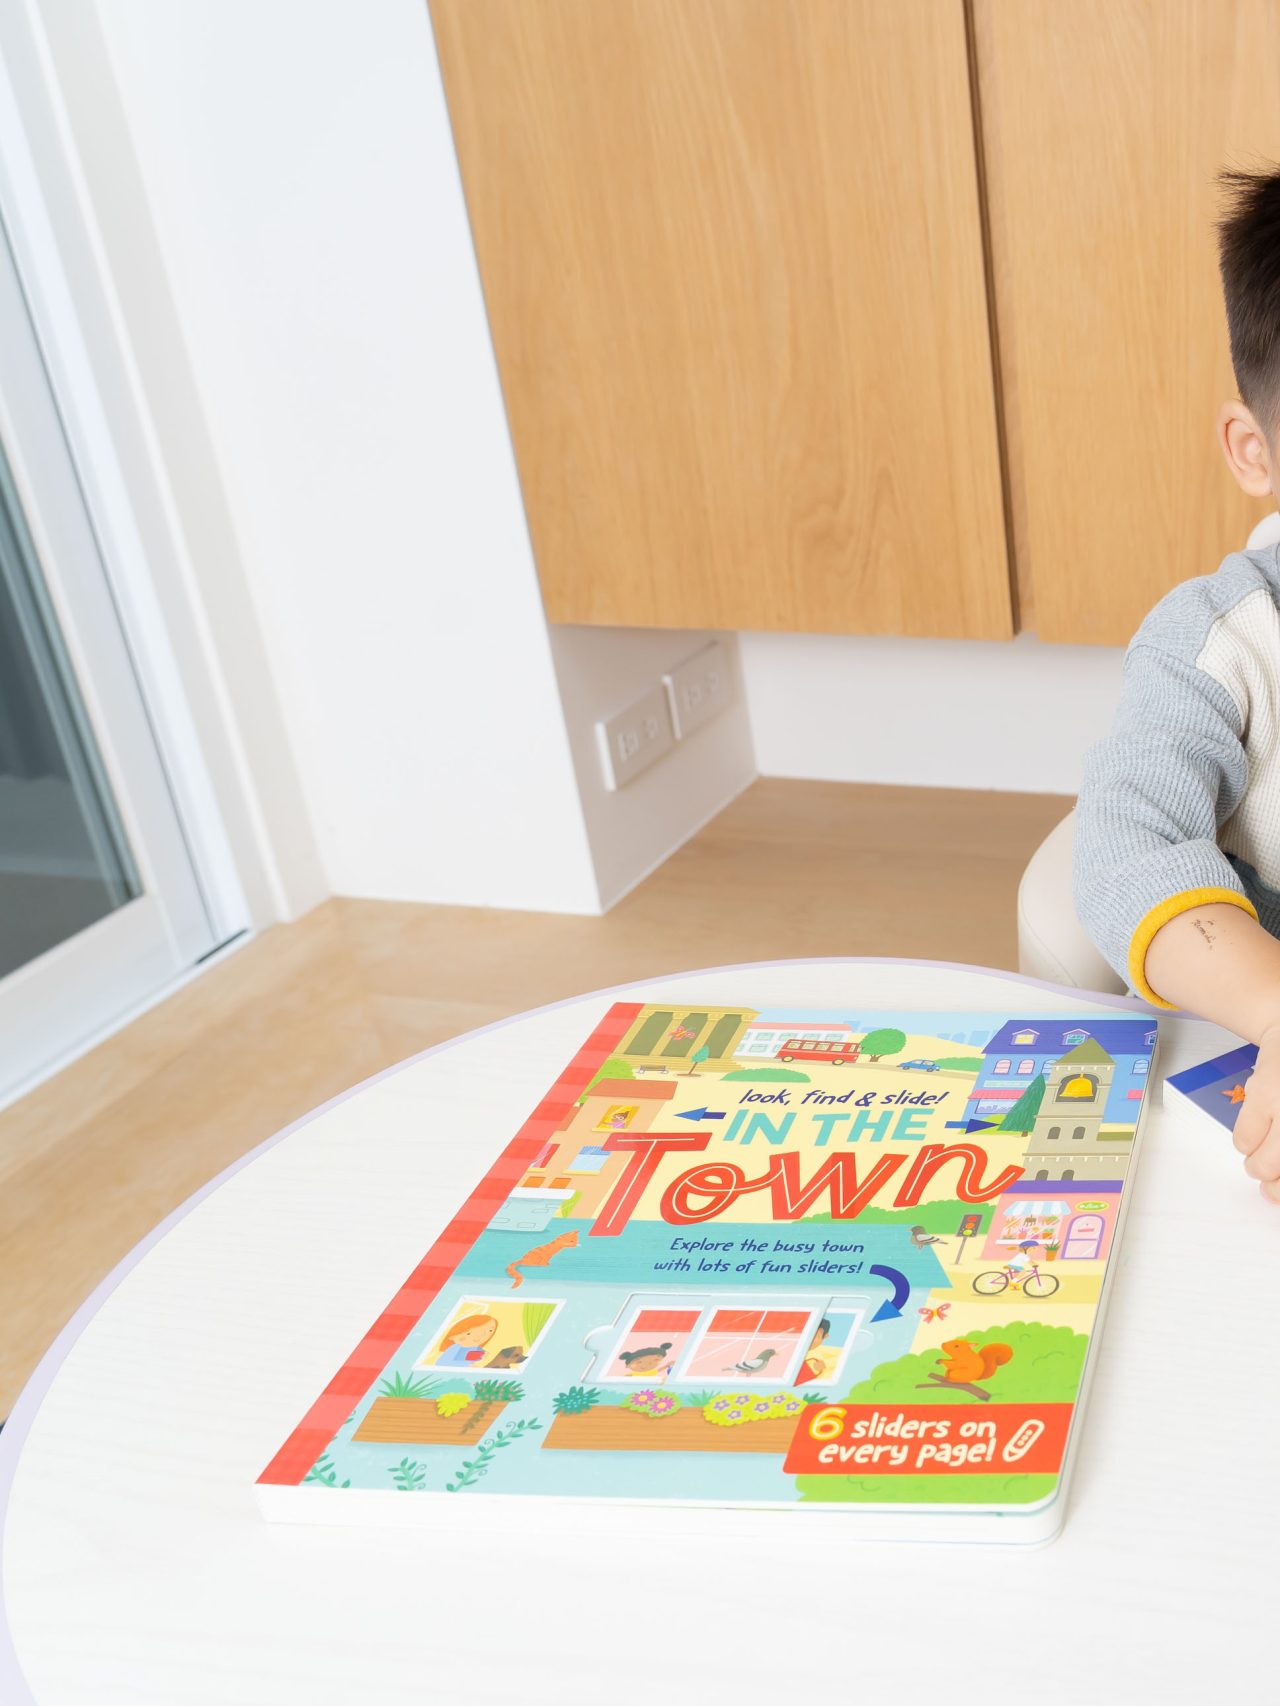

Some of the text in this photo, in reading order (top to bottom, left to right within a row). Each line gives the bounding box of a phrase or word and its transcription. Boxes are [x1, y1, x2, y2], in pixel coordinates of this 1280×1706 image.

[739, 1089, 950, 1107] look, find & slide!
[723, 1108, 935, 1146] IN THE
[588, 1132, 1025, 1236] Town
[670, 1237, 864, 1253] Explore the busy town
[653, 1258, 864, 1274] with lots of fun sliders!
[808, 1407, 997, 1441] 6 sliders on
[818, 1437, 997, 1468] every page!
